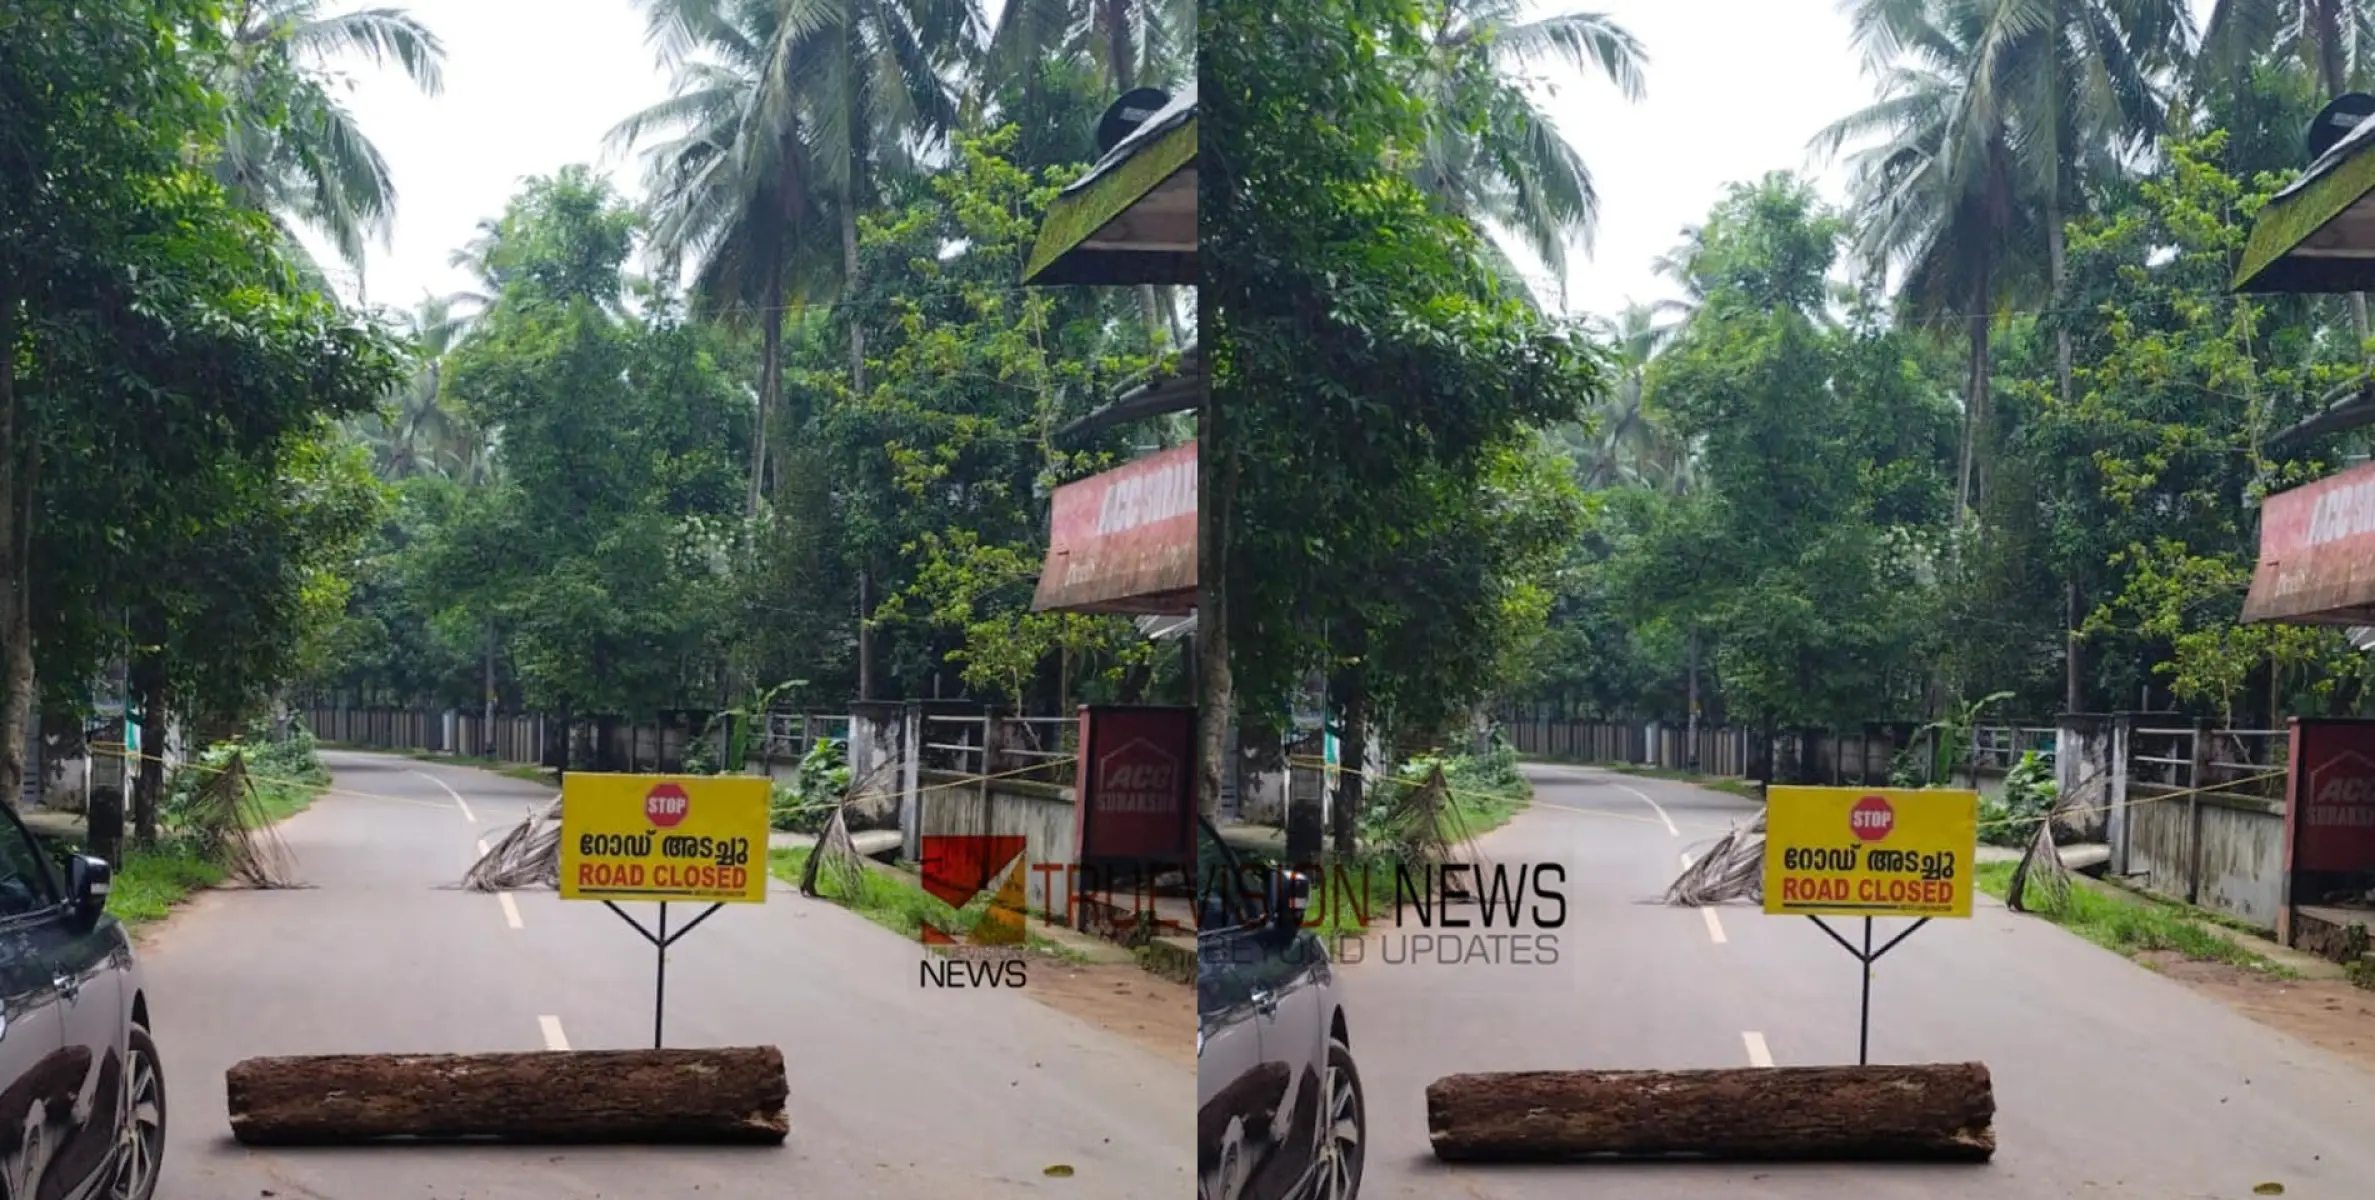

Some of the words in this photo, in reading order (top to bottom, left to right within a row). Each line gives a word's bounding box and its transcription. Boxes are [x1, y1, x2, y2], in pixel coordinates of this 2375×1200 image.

[1107, 763, 1171, 789] ACC
[648, 797, 686, 814] STOP
[1853, 810, 1891, 828] STOP
[580, 830, 656, 858] റോഡ്
[662, 836, 749, 866] അടച്ചു
[1784, 843, 1861, 871] റോഡ്
[1867, 849, 1955, 880] അടച്ചു
[578, 863, 645, 887] ROAD
[653, 865, 748, 889] CLOSED
[1782, 877, 1850, 901] ROAD
[1858, 879, 1954, 904] CLOSED
